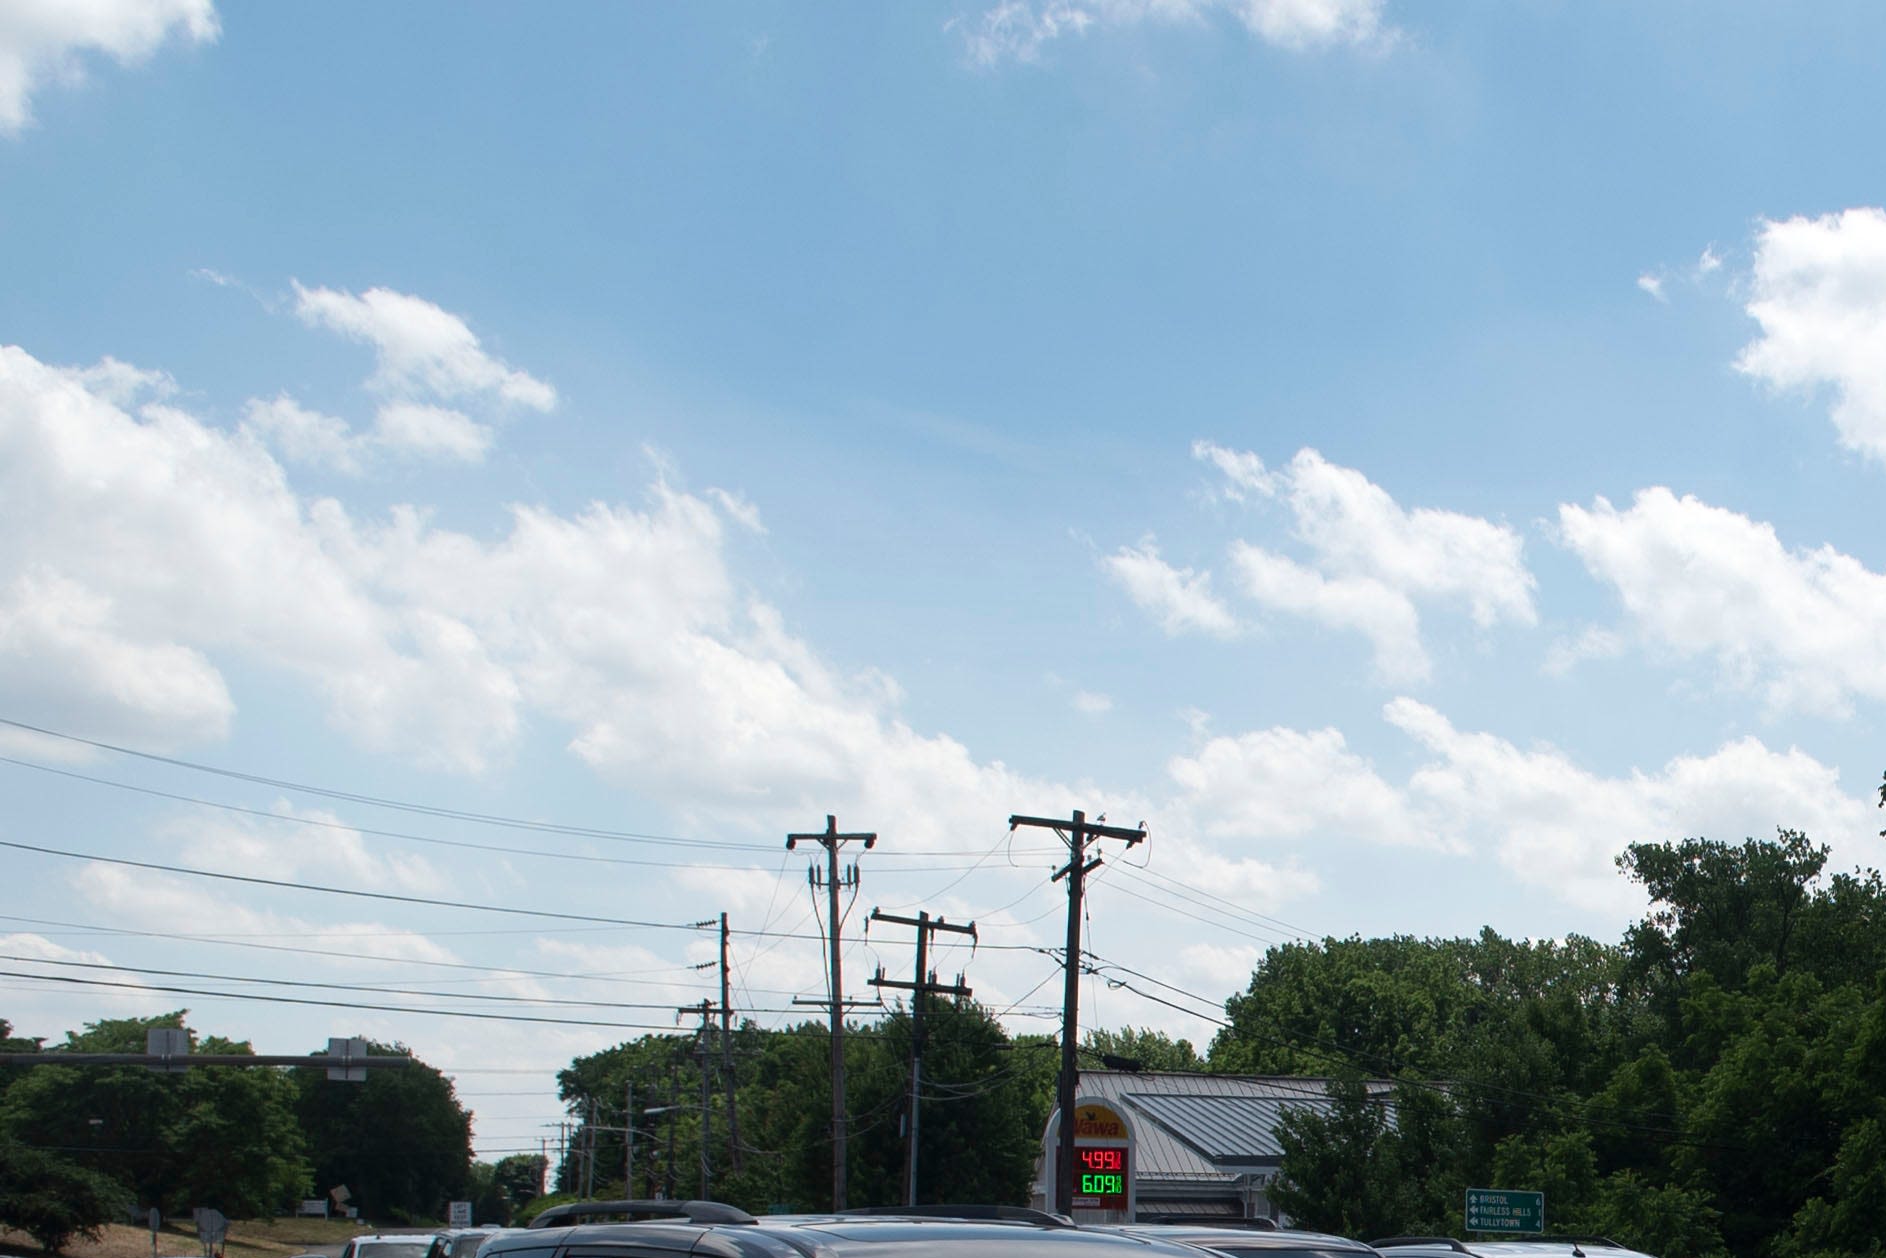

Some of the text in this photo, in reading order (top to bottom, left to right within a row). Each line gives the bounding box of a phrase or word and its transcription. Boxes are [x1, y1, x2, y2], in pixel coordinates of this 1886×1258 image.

[1480, 1195, 1508, 1205] BRISTOL
[1480, 1206, 1510, 1216] FAIRLESS
[1512, 1207, 1531, 1217] HILLS
[1480, 1218, 1520, 1228] TULLYTOWN
